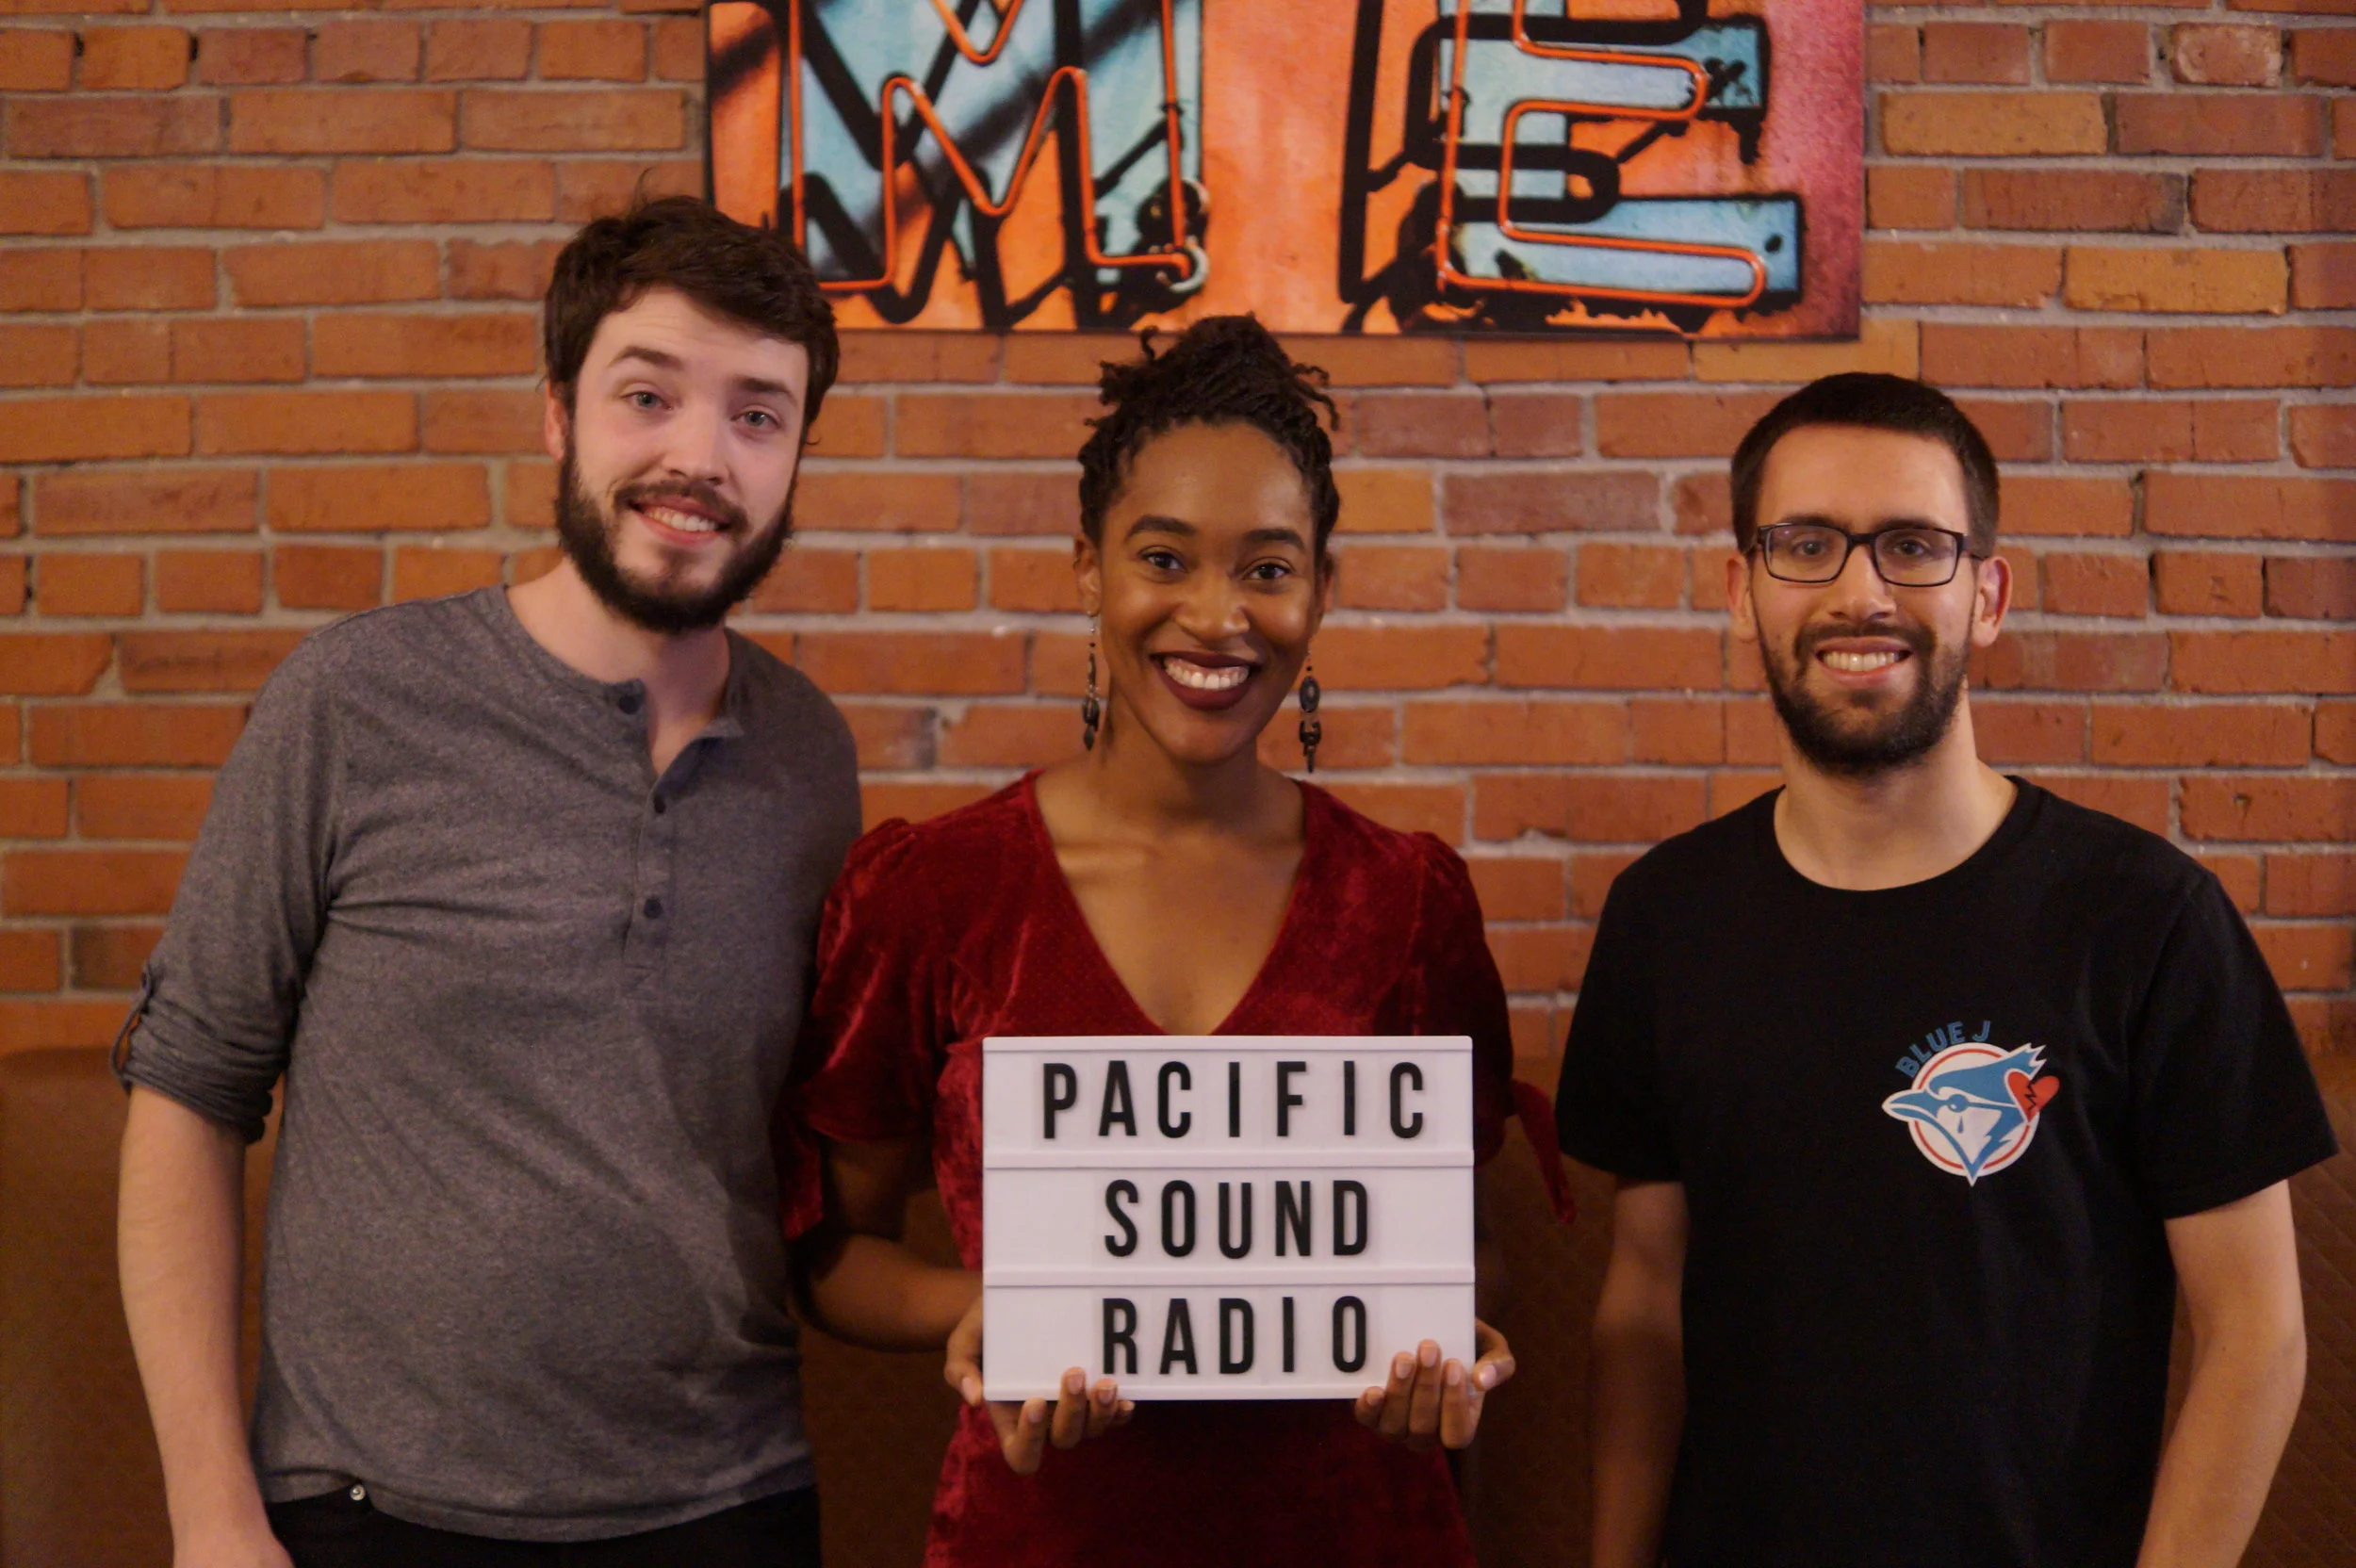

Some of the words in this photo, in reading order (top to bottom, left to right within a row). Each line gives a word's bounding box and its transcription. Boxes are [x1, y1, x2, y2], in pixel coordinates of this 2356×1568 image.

[1895, 1021, 1966, 1079] BLUE
[1972, 1020, 1991, 1042] J
[1042, 1060, 1424, 1139] PACIFIC
[1104, 1179, 1368, 1259] SOUND
[1102, 1295, 1367, 1375] RADIO
